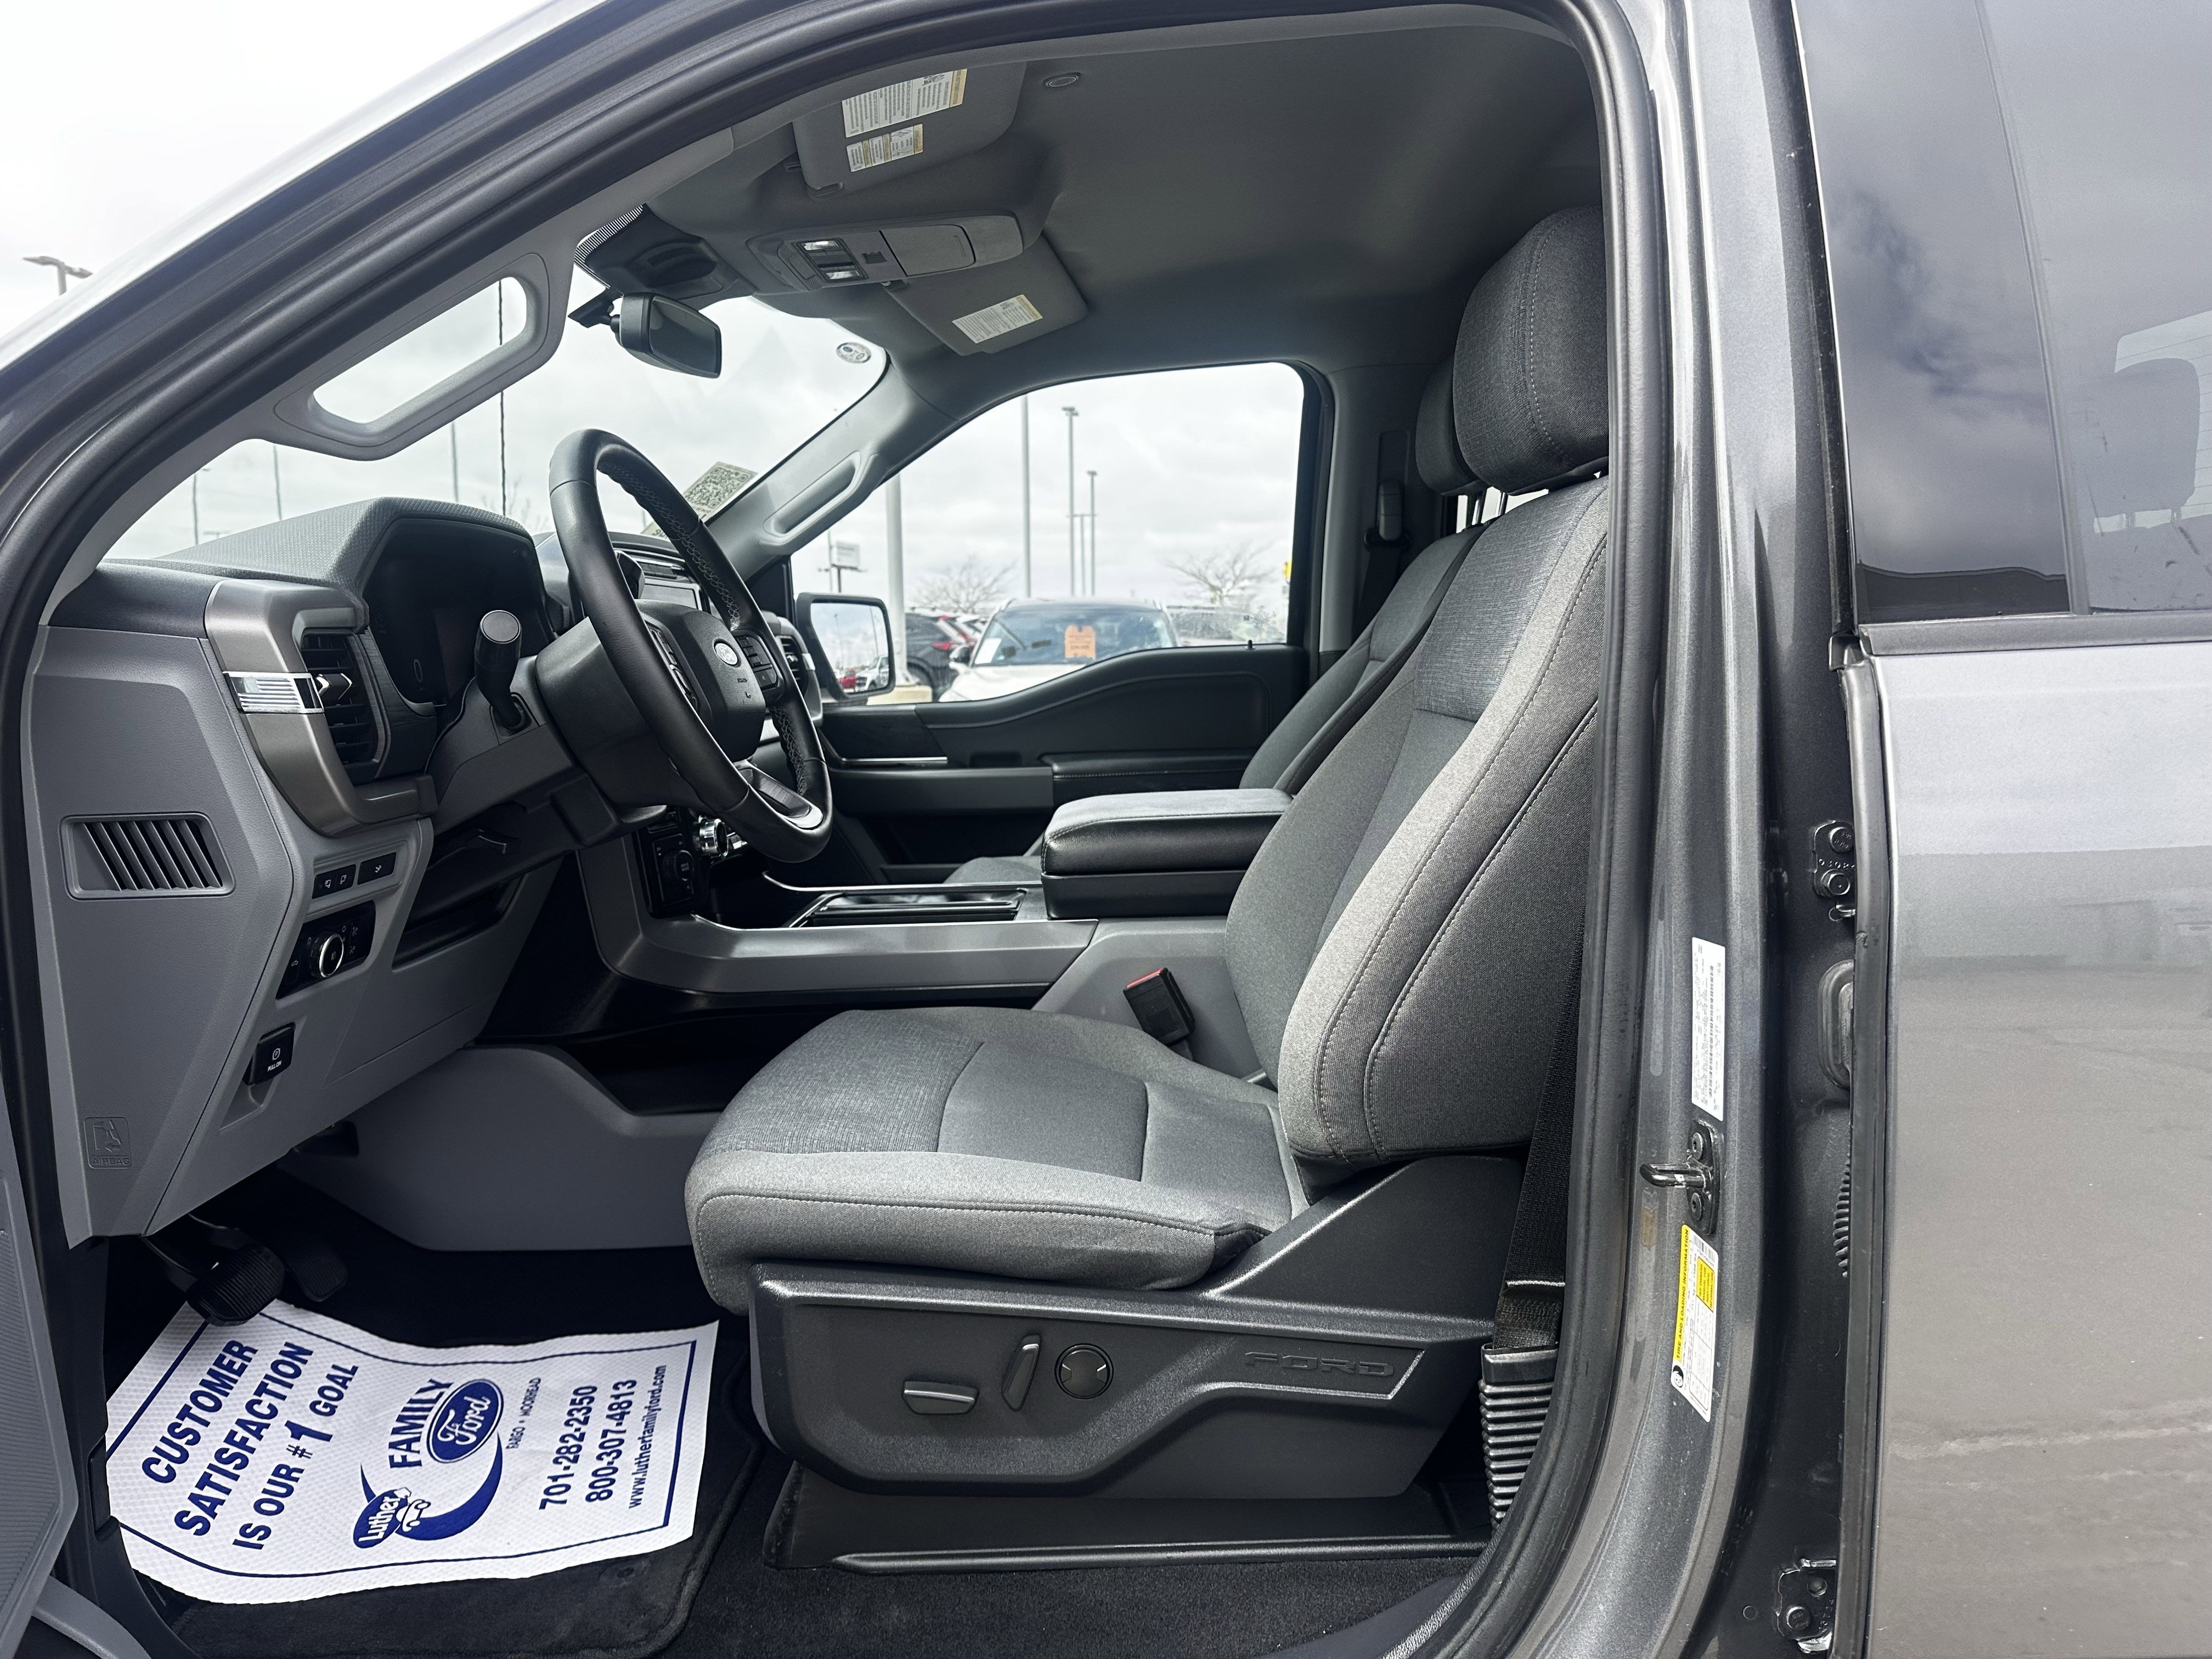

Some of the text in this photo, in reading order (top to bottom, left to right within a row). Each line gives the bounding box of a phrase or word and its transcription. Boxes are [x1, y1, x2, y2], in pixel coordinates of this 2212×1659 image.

[268, 1063, 276, 1072] PULL
[142, 1340, 258, 1483] CUSTOMER
[505, 1377, 541, 1449] FARGO MOORHEAD
[1244, 1351, 1395, 1377] FORD
[174, 1341, 314, 1536] SATISFACTION
[232, 1363, 359, 1550] IS OUR #1 GOAL
[388, 1378, 455, 1469] FAMILY
[439, 1395, 492, 1447] Ford
[539, 1385, 599, 1511] 701-282-2350
[585, 1378, 638, 1504] 800-307-4813
[629, 1364, 667, 1509] www.lutherfamilyford.com
[358, 1496, 401, 1542] Luther
